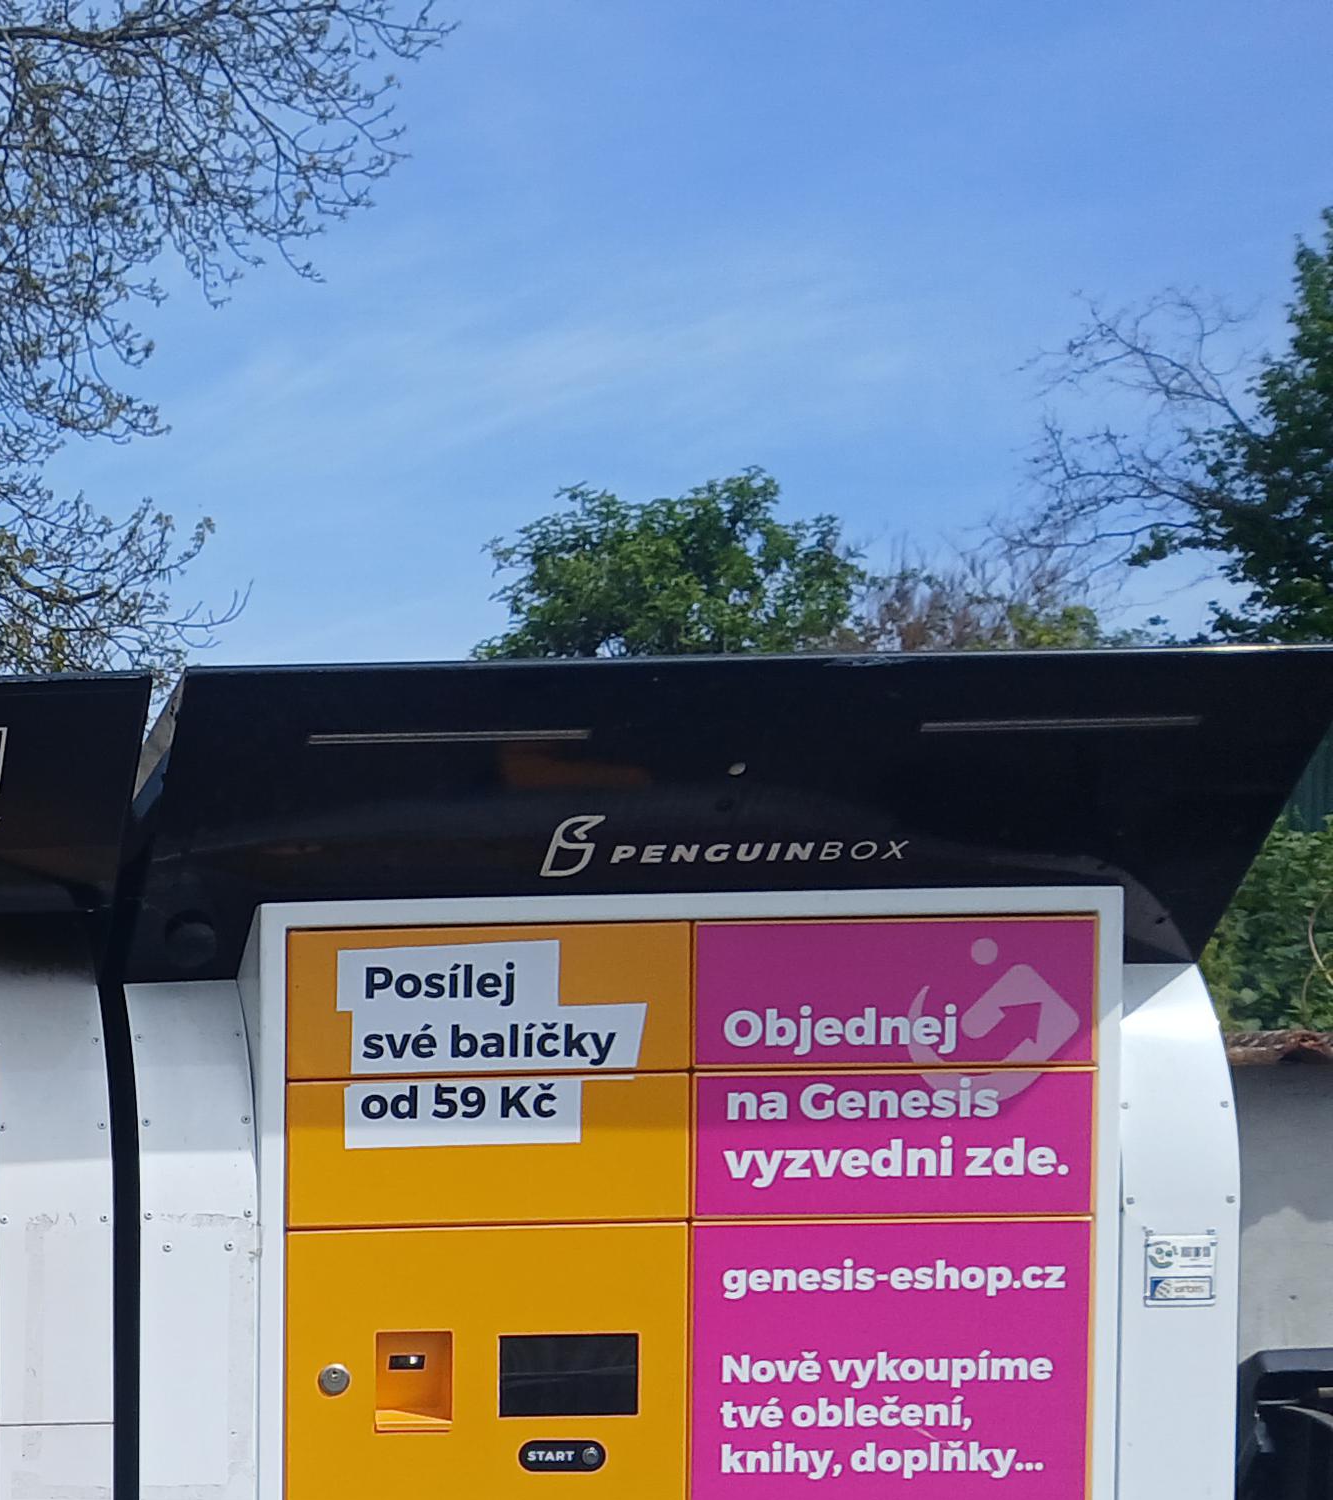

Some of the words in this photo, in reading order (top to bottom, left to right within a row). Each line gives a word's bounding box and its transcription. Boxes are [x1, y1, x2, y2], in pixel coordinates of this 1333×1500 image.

[609, 840, 910, 864] PENGUINBOX
[364, 962, 516, 1007] Posílej
[362, 1024, 437, 1060] své
[450, 1022, 617, 1066] balíčky
[723, 1003, 958, 1056] Objednej
[360, 1085, 419, 1119] od
[432, 1083, 487, 1119] 59
[500, 1083, 558, 1119] Kč
[726, 1090, 788, 1121] na
[799, 1077, 1000, 1120] Genesis
[723, 1135, 953, 1188] vyzvedni
[964, 1137, 1070, 1178] zde.
[722, 1258, 1067, 1300] genesis-eshop.cz
[721, 1350, 822, 1384] Nově
[829, 1349, 1054, 1390] vykoupíme
[720, 1397, 784, 1429] tvé
[791, 1395, 973, 1431] oblečení,
[526, 1450, 575, 1462] START
[720, 1441, 843, 1480] knihy,
[850, 1440, 1045, 1480] doplňky...
